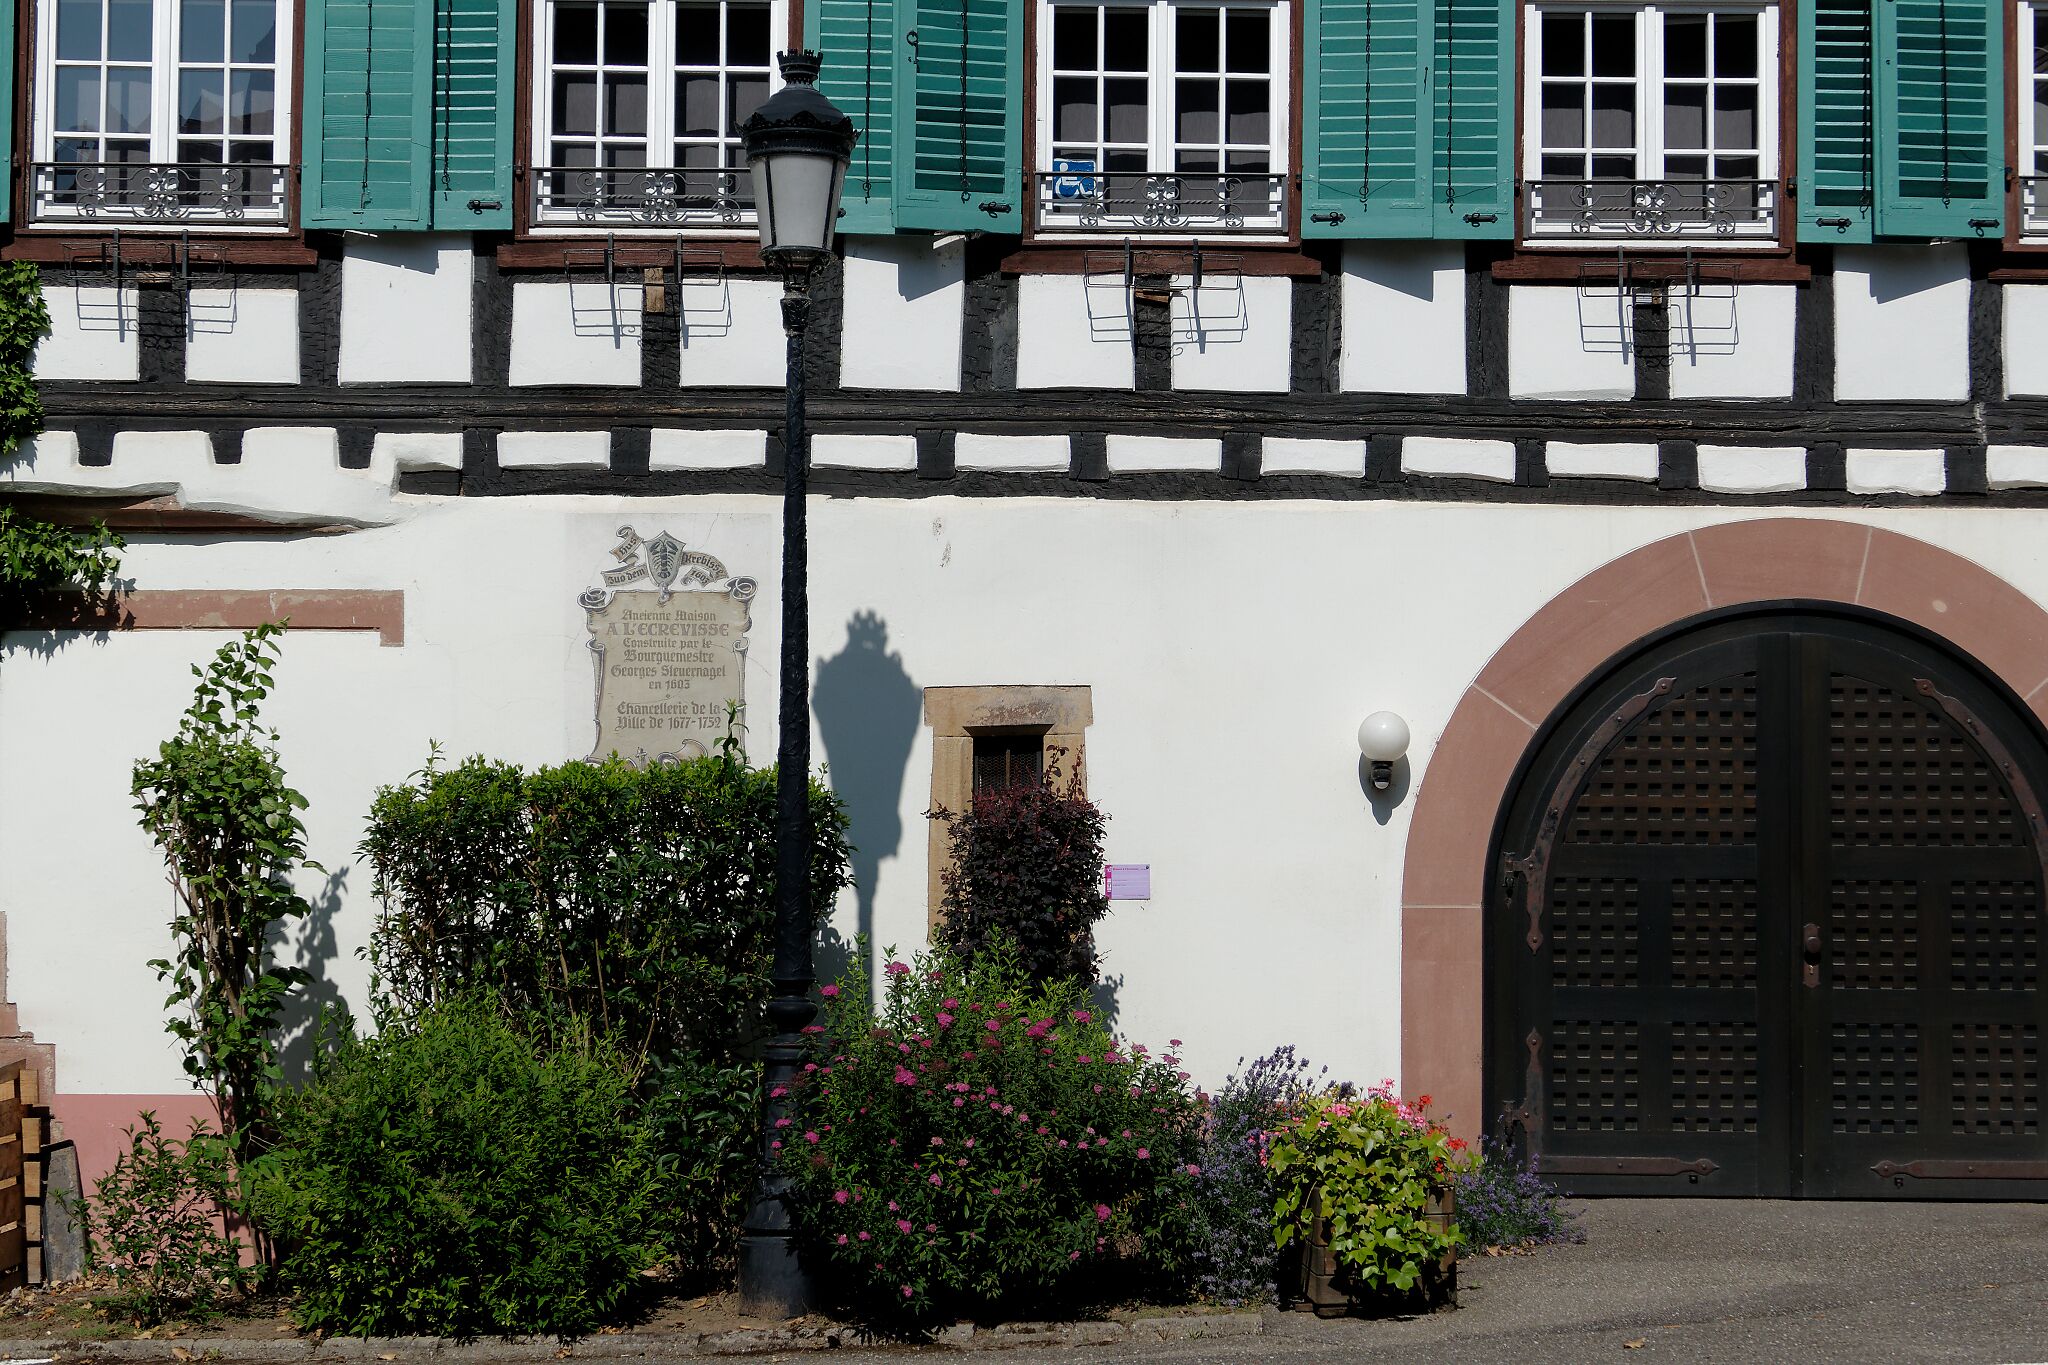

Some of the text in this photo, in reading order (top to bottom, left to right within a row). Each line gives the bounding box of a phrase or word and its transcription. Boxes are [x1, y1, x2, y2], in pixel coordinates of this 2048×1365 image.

[626, 568, 645, 581] dem
[622, 609, 716, 621] Ancienne Maison
[607, 622, 729, 636] A L'ECREVISSE
[623, 637, 712, 650] Construite par le
[624, 649, 714, 664] Bourguemestre
[611, 664, 657, 679] Georges
[648, 679, 690, 690] en 1603
[617, 701, 721, 715] Chancellerie de la
[615, 716, 646, 731] Ville
[649, 716, 663, 729] de
